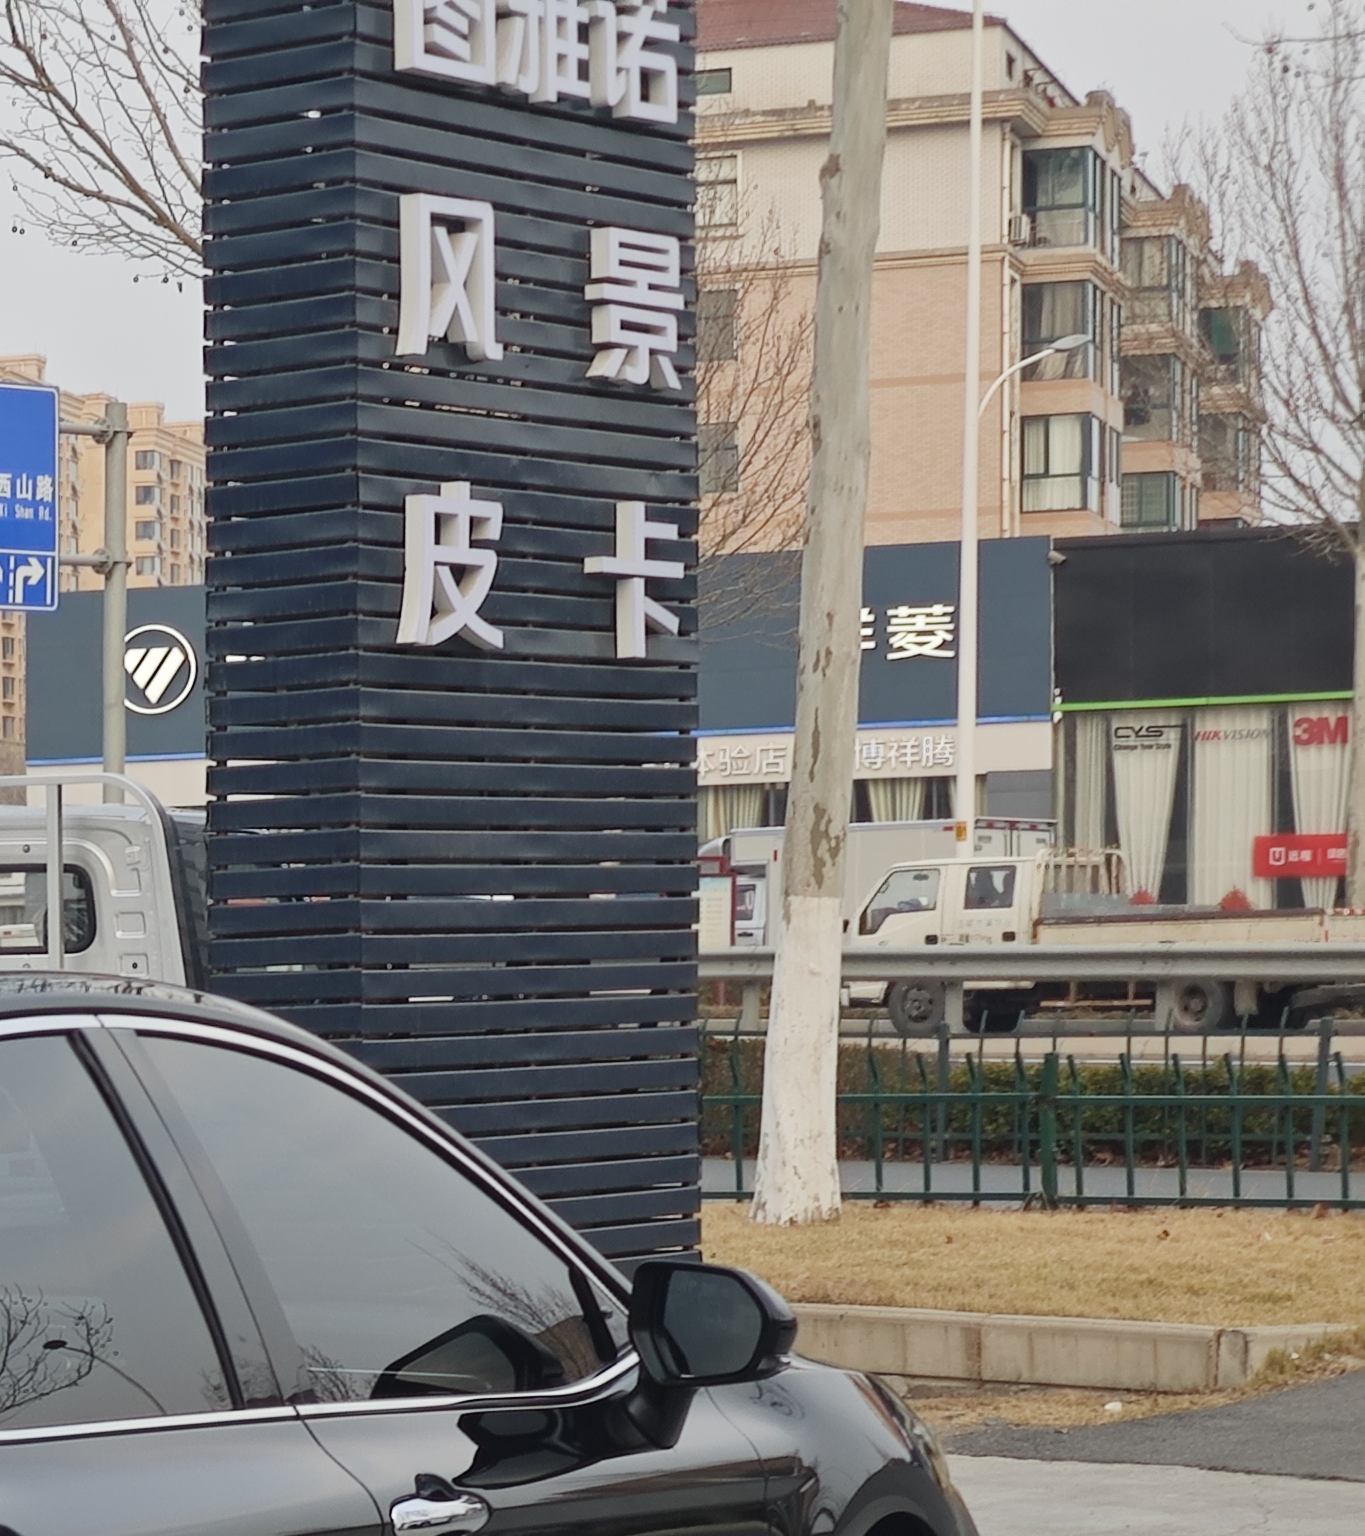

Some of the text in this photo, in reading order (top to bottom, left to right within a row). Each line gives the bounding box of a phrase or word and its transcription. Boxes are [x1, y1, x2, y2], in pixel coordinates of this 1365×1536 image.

[396, 193, 684, 390] 风景
[396, 481, 684, 659] 皮卡
[860, 604, 955, 660] 菱
[1293, 716, 1348, 746] 3M
